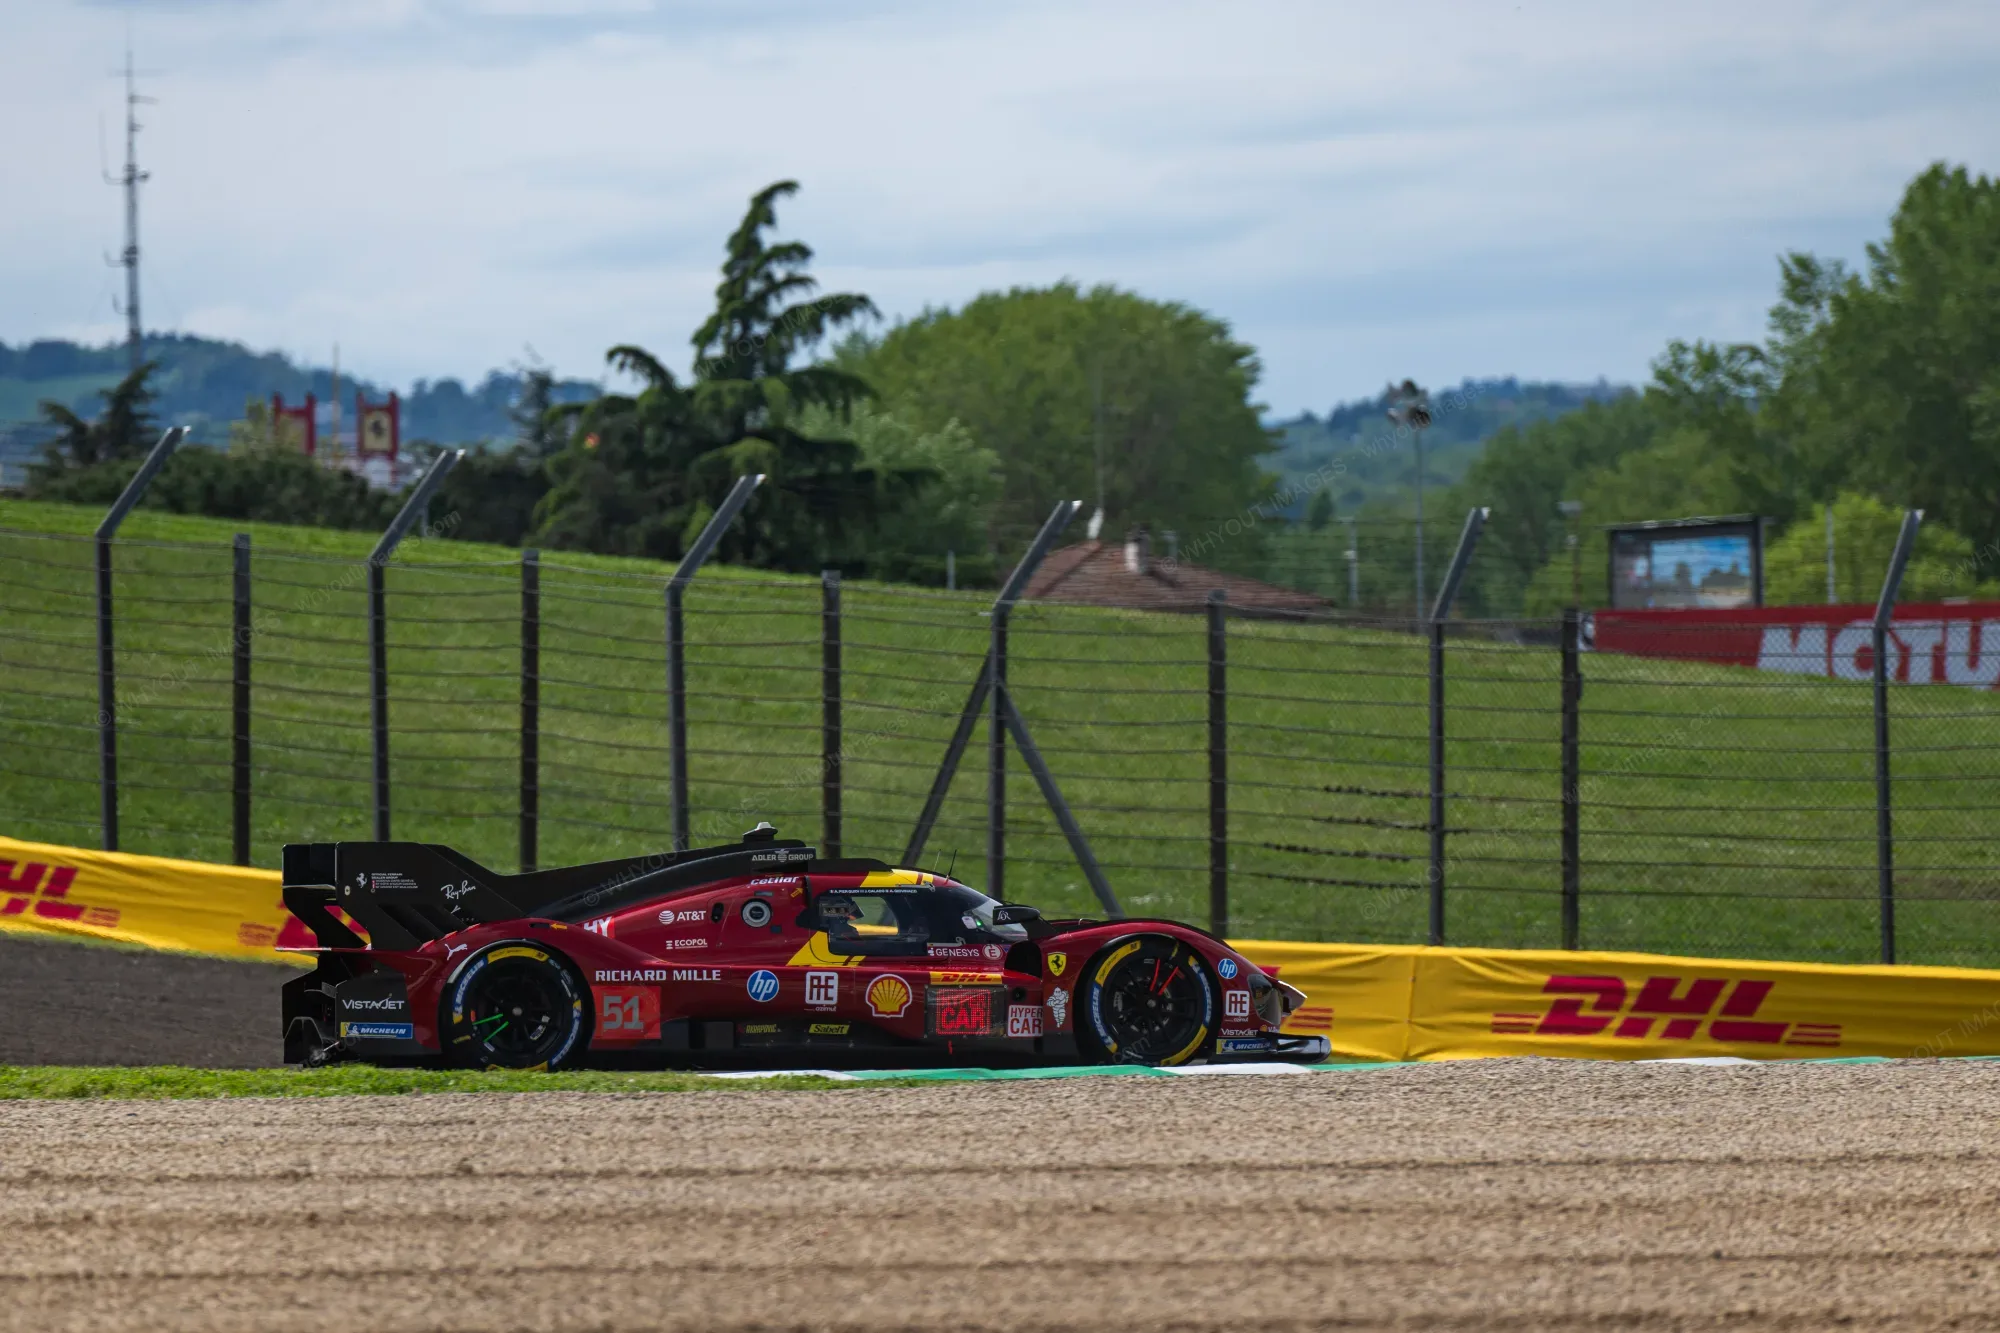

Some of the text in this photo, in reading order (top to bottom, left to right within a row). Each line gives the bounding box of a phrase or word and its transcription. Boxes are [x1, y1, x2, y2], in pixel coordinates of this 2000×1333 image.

[1757, 619, 2000, 690] MOTU
[752, 853, 814, 862] ADLER GROUP
[441, 880, 476, 900] Ray-Ban
[676, 910, 707, 922] AT&T
[674, 938, 708, 947] ECOPOL
[935, 948, 980, 957] GENESYS
[595, 969, 722, 982] RICHARD MILLE
[940, 972, 994, 982] DHL
[603, 995, 645, 1030] 51
[1010, 1007, 1043, 1018] HYPER
[1534, 975, 1790, 1043] DHL
[941, 1008, 985, 1028] CAR
[360, 1027, 406, 1035] MICHELIN
[813, 1024, 844, 1034] Sabelt
[1010, 1017, 1042, 1035] CAR
